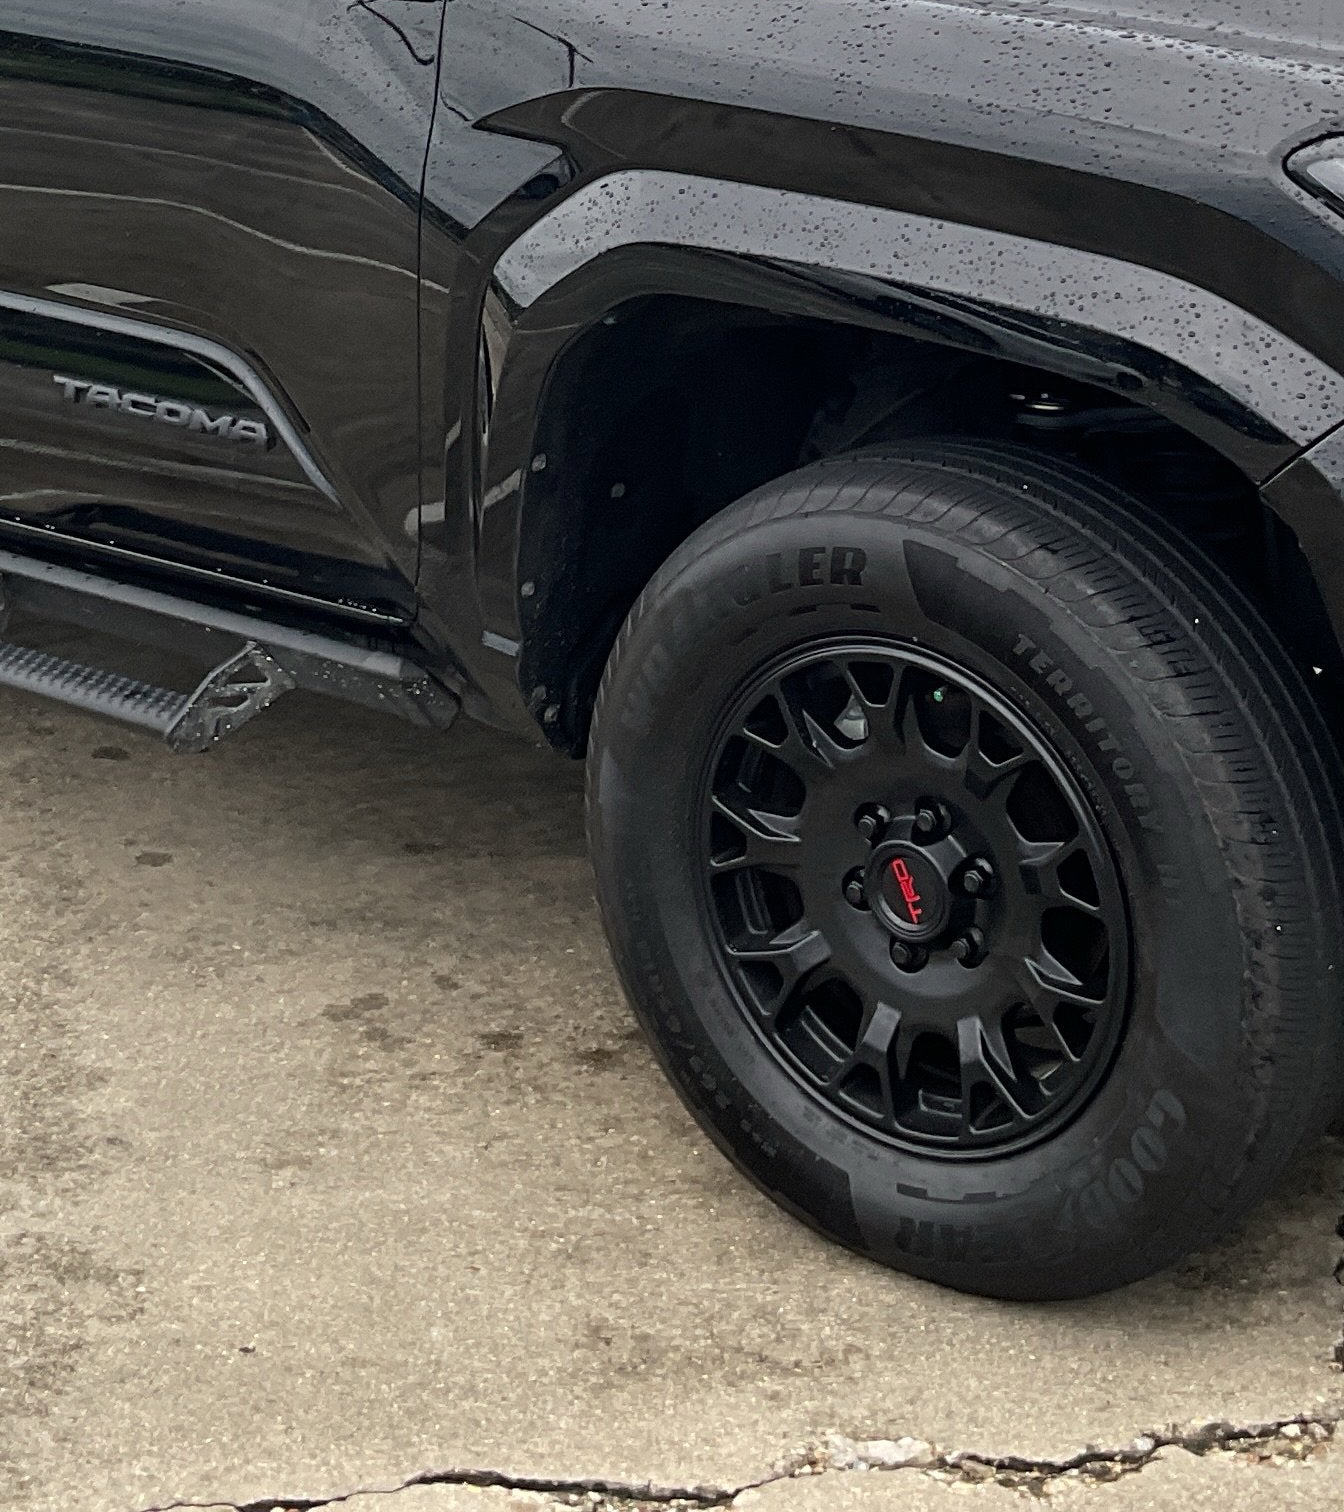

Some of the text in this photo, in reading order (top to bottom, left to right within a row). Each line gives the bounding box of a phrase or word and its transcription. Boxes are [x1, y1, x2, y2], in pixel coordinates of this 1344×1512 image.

[53, 375, 272, 451] TACOMA
[1011, 632, 1163, 831] TERRITORY
[891, 858, 922, 924] TRD
